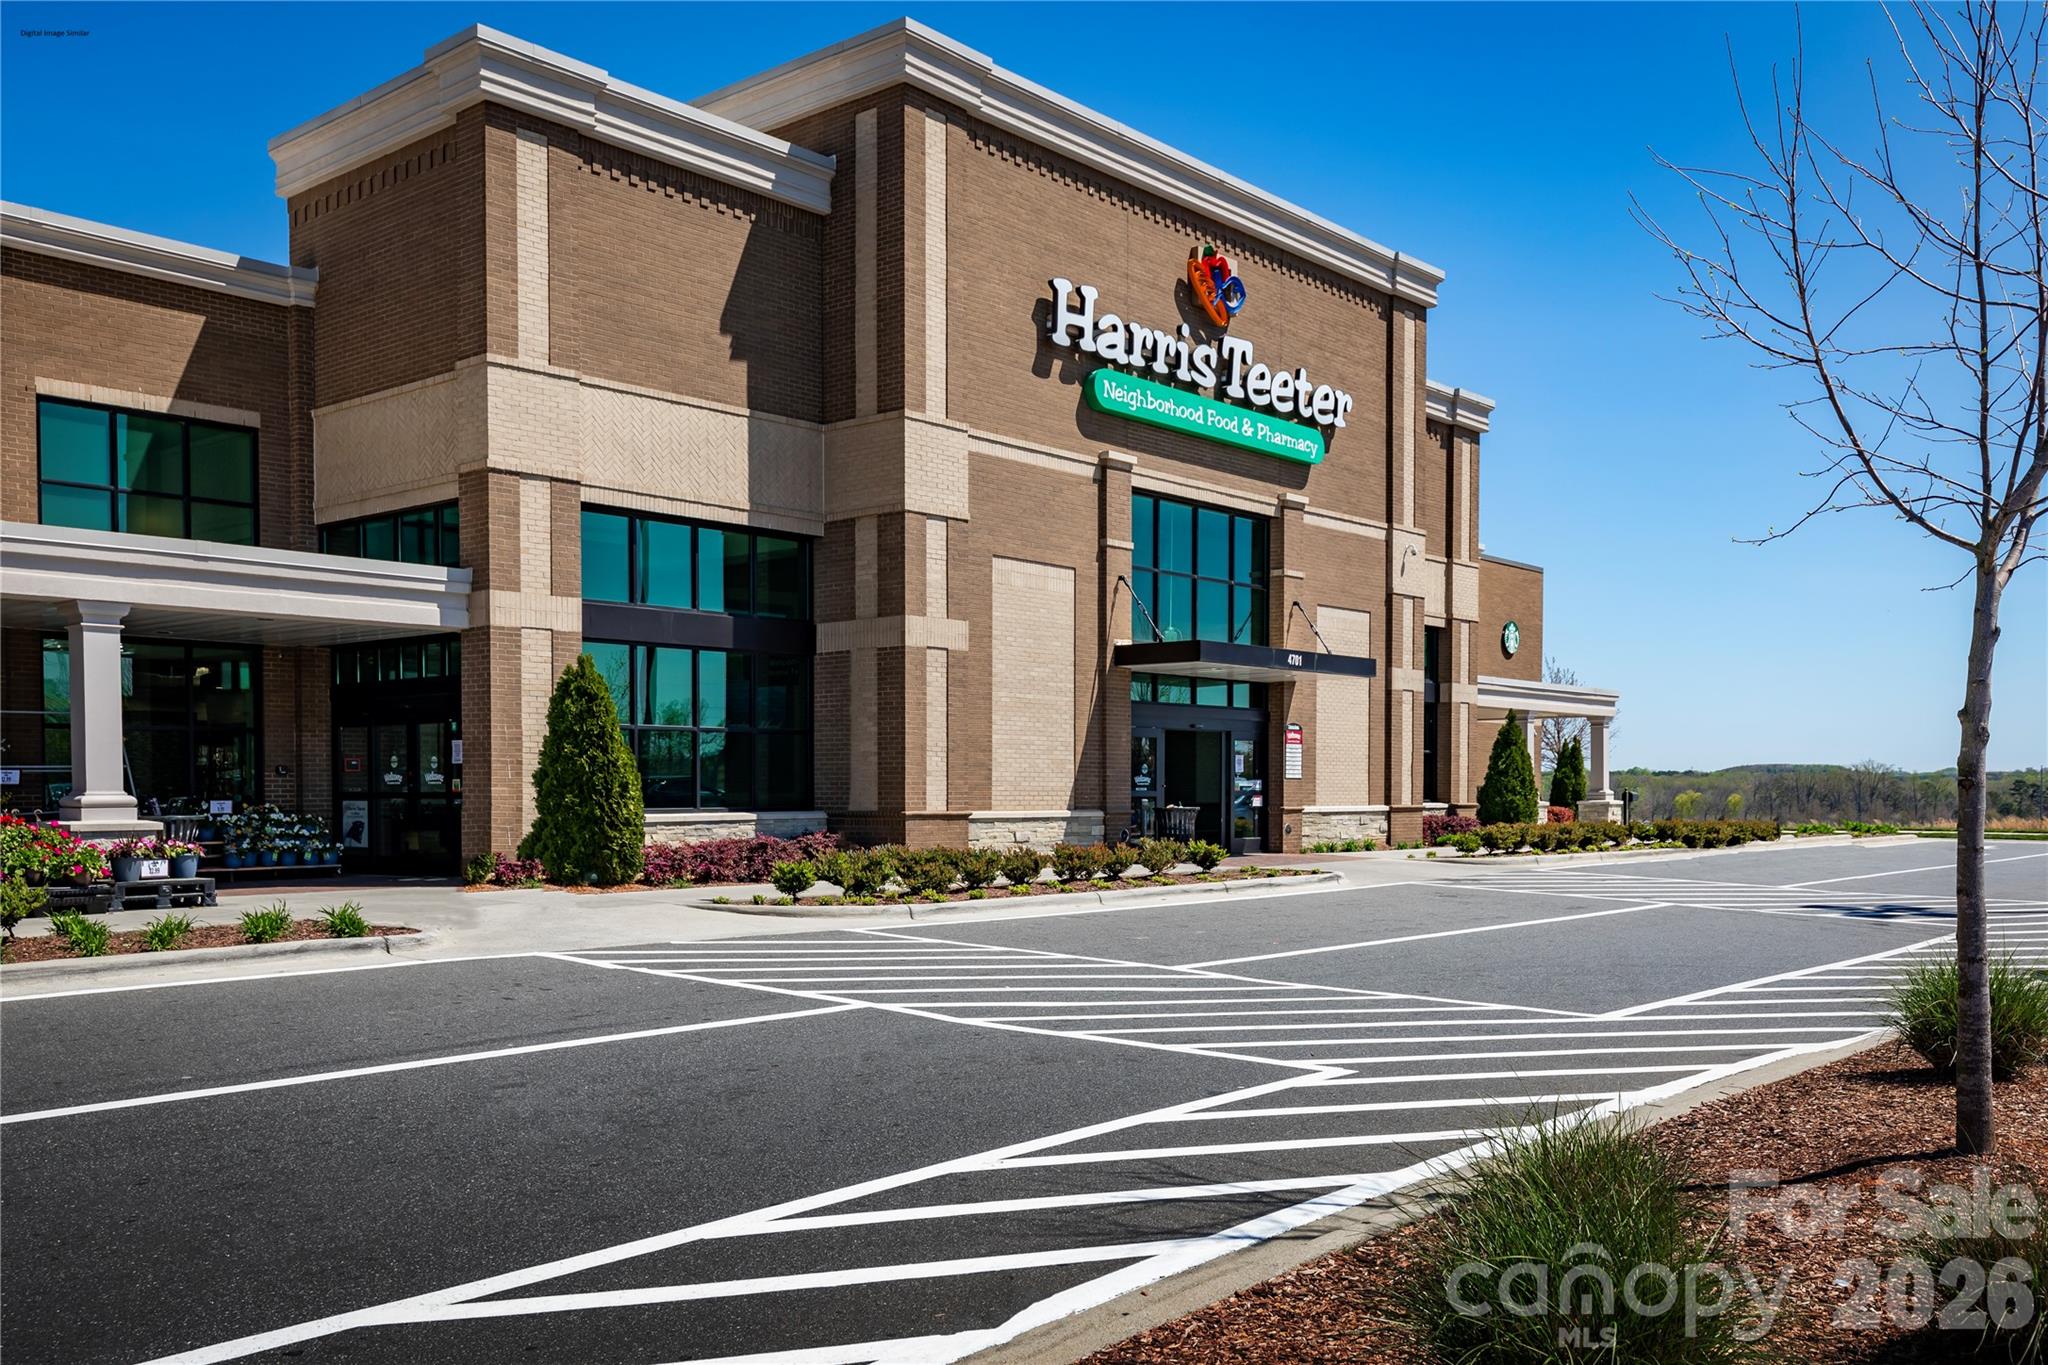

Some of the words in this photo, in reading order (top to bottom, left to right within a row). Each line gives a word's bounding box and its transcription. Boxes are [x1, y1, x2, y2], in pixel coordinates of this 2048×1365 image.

[1052, 277, 1217, 388] Harris
[1222, 335, 1353, 428] Teeter
[1103, 380, 1204, 425] Neighborhood
[1207, 409, 1239, 434] Food
[1242, 418, 1254, 437] &
[1257, 423, 1319, 459] Pharmacy
[1287, 653, 1303, 667] 4701
